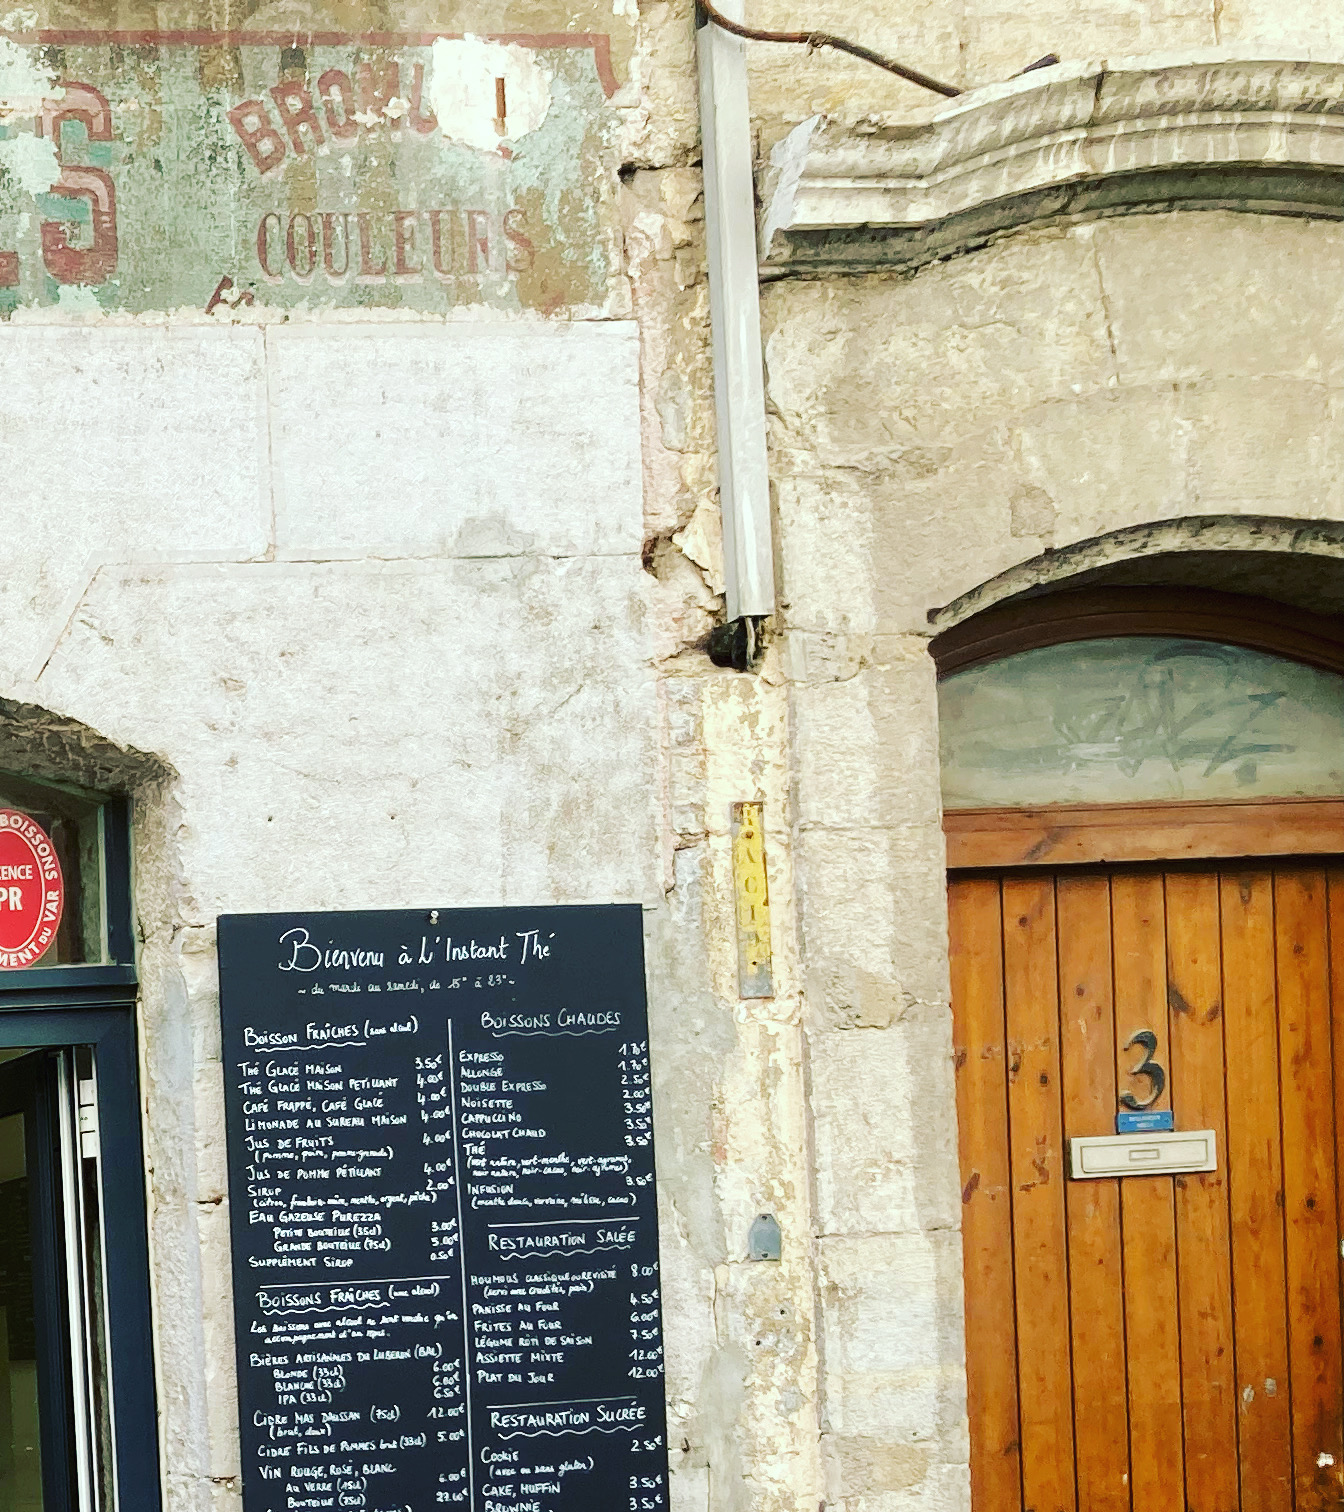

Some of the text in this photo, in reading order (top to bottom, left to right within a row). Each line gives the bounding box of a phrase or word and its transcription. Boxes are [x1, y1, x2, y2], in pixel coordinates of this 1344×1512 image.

[43, 890, 60, 922] VAR
[39, 927, 51, 944] DU
[278, 928, 384, 971] Bienvenu
[398, 946, 412, 964] à
[516, 930, 555, 964] Thé
[481, 1008, 621, 1029] BOISSONS CHAUDES
[1119, 1028, 1166, 1110] 3
[488, 1226, 636, 1251] RESTAURATION SALÉE
[256, 1291, 322, 1309] BOISSONS
[491, 1401, 646, 1429] RESTAURATION SUCRÉE
